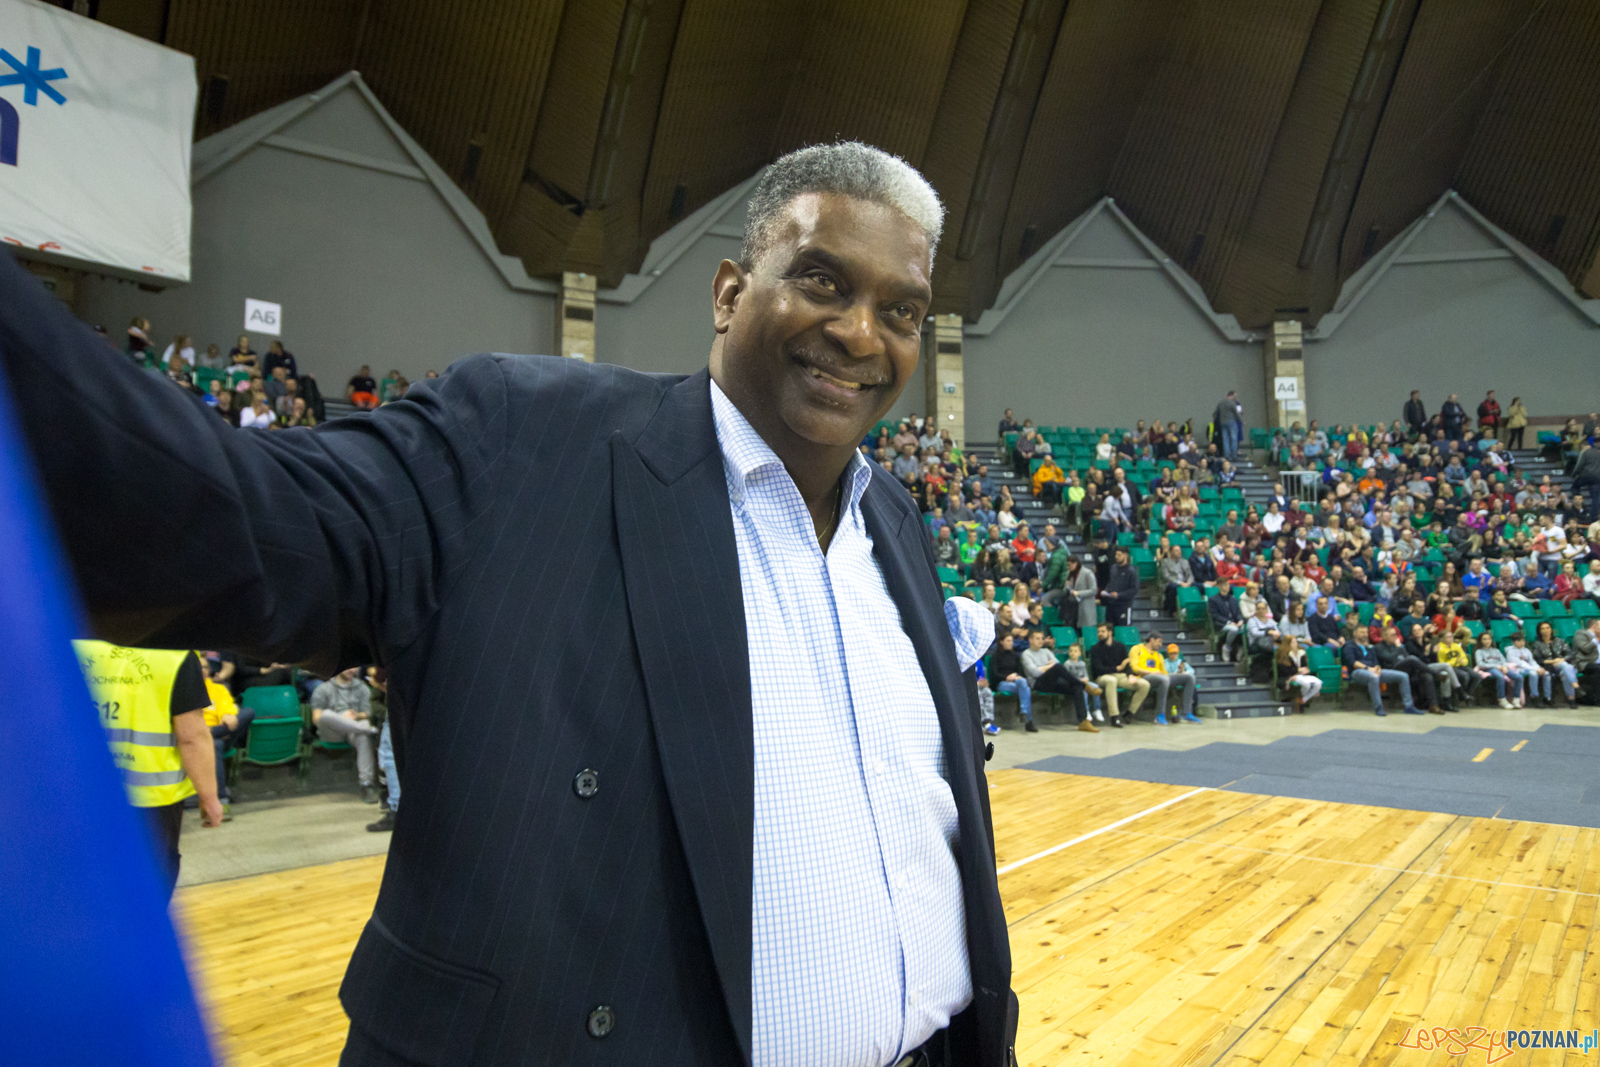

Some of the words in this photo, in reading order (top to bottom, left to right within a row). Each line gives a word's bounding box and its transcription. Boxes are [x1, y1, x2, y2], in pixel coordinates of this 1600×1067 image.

[250, 308, 276, 326] A6
[1277, 382, 1295, 392] A4
[1032, 500, 1042, 508] 11
[1047, 517, 1060, 525] 10
[110, 647, 153, 682] SERVICE
[90, 675, 133, 684] OCHRNA
[1224, 708, 1232, 718] 1
[1277, 706, 1285, 716] 1
